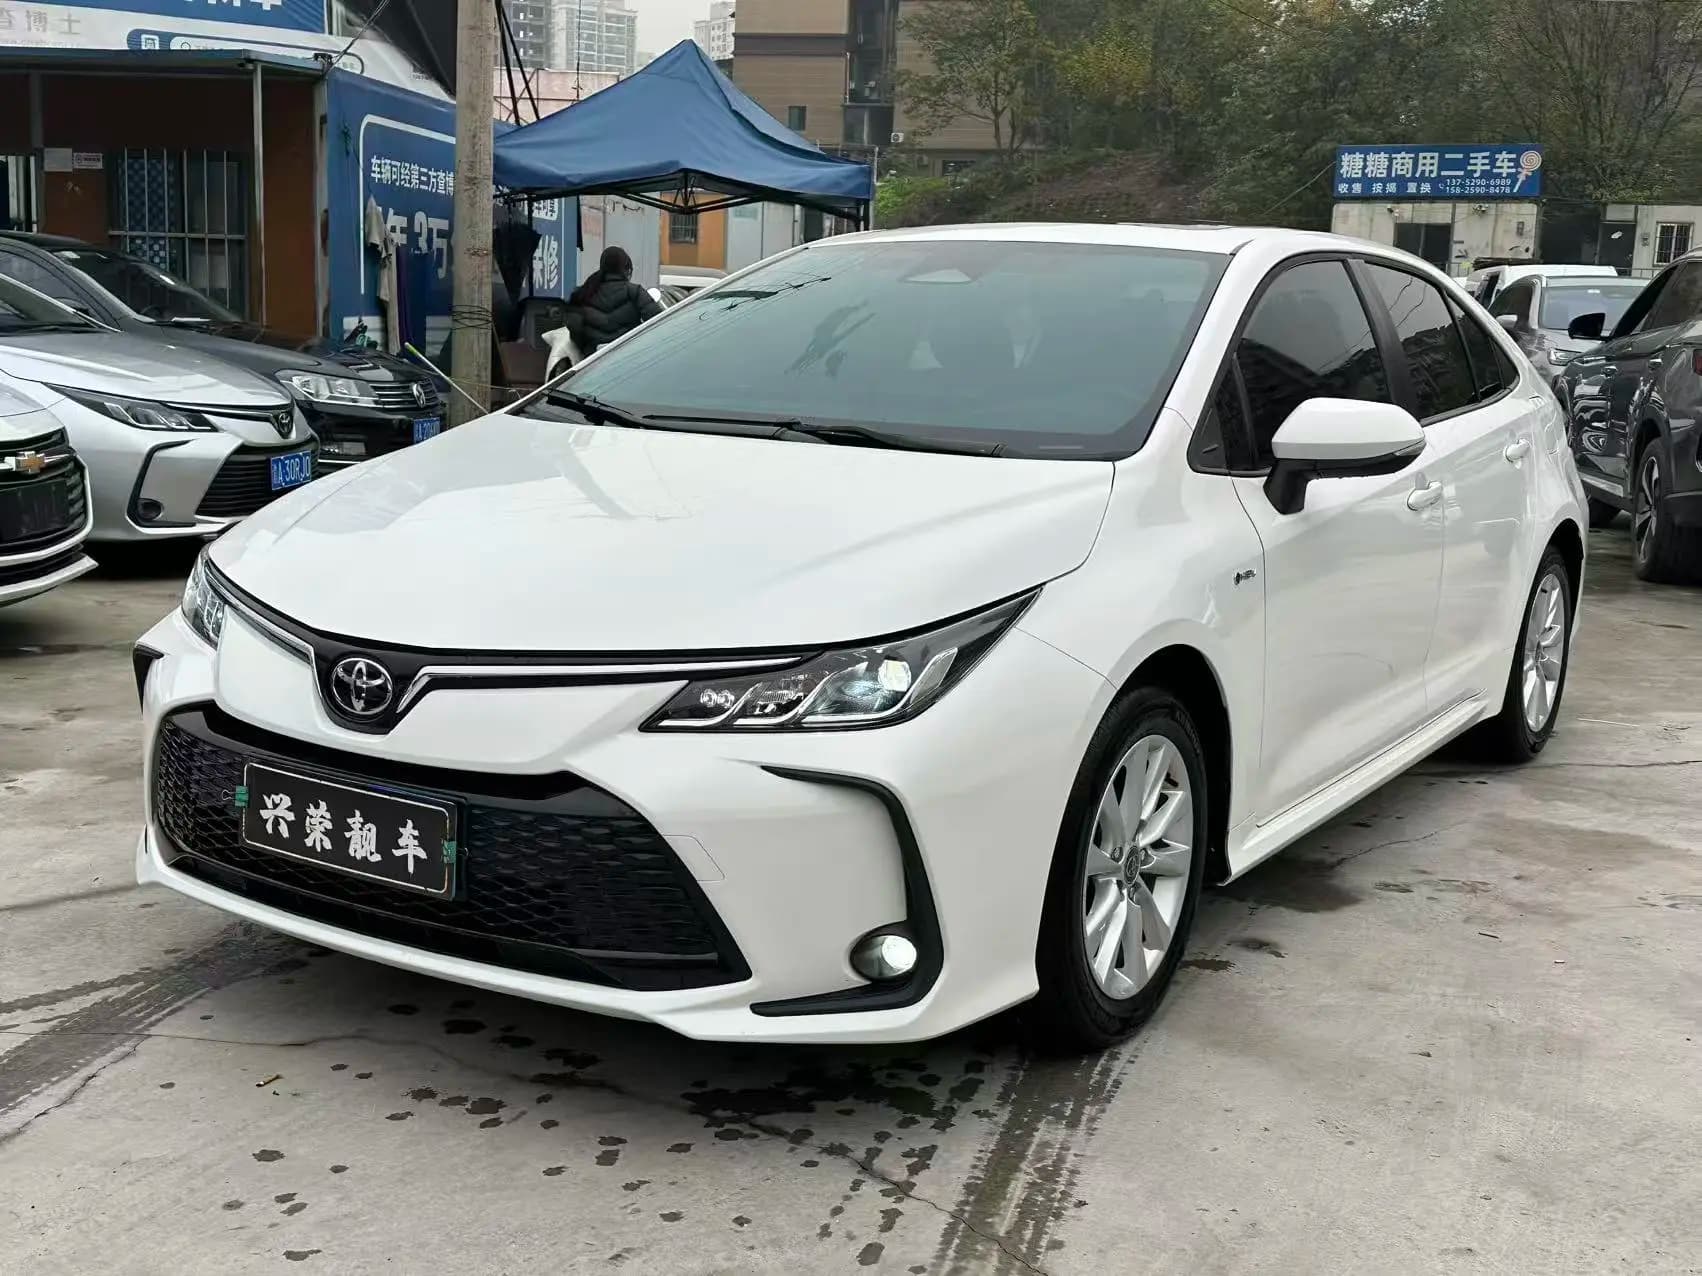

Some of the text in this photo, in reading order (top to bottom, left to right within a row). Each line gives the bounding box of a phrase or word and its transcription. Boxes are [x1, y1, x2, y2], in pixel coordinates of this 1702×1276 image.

[1340, 151, 1517, 178] 糖糖商用二手车
[1338, 181, 1432, 194] 收售 按揭 置换
[259, 793, 428, 876] 兴荣靓车
